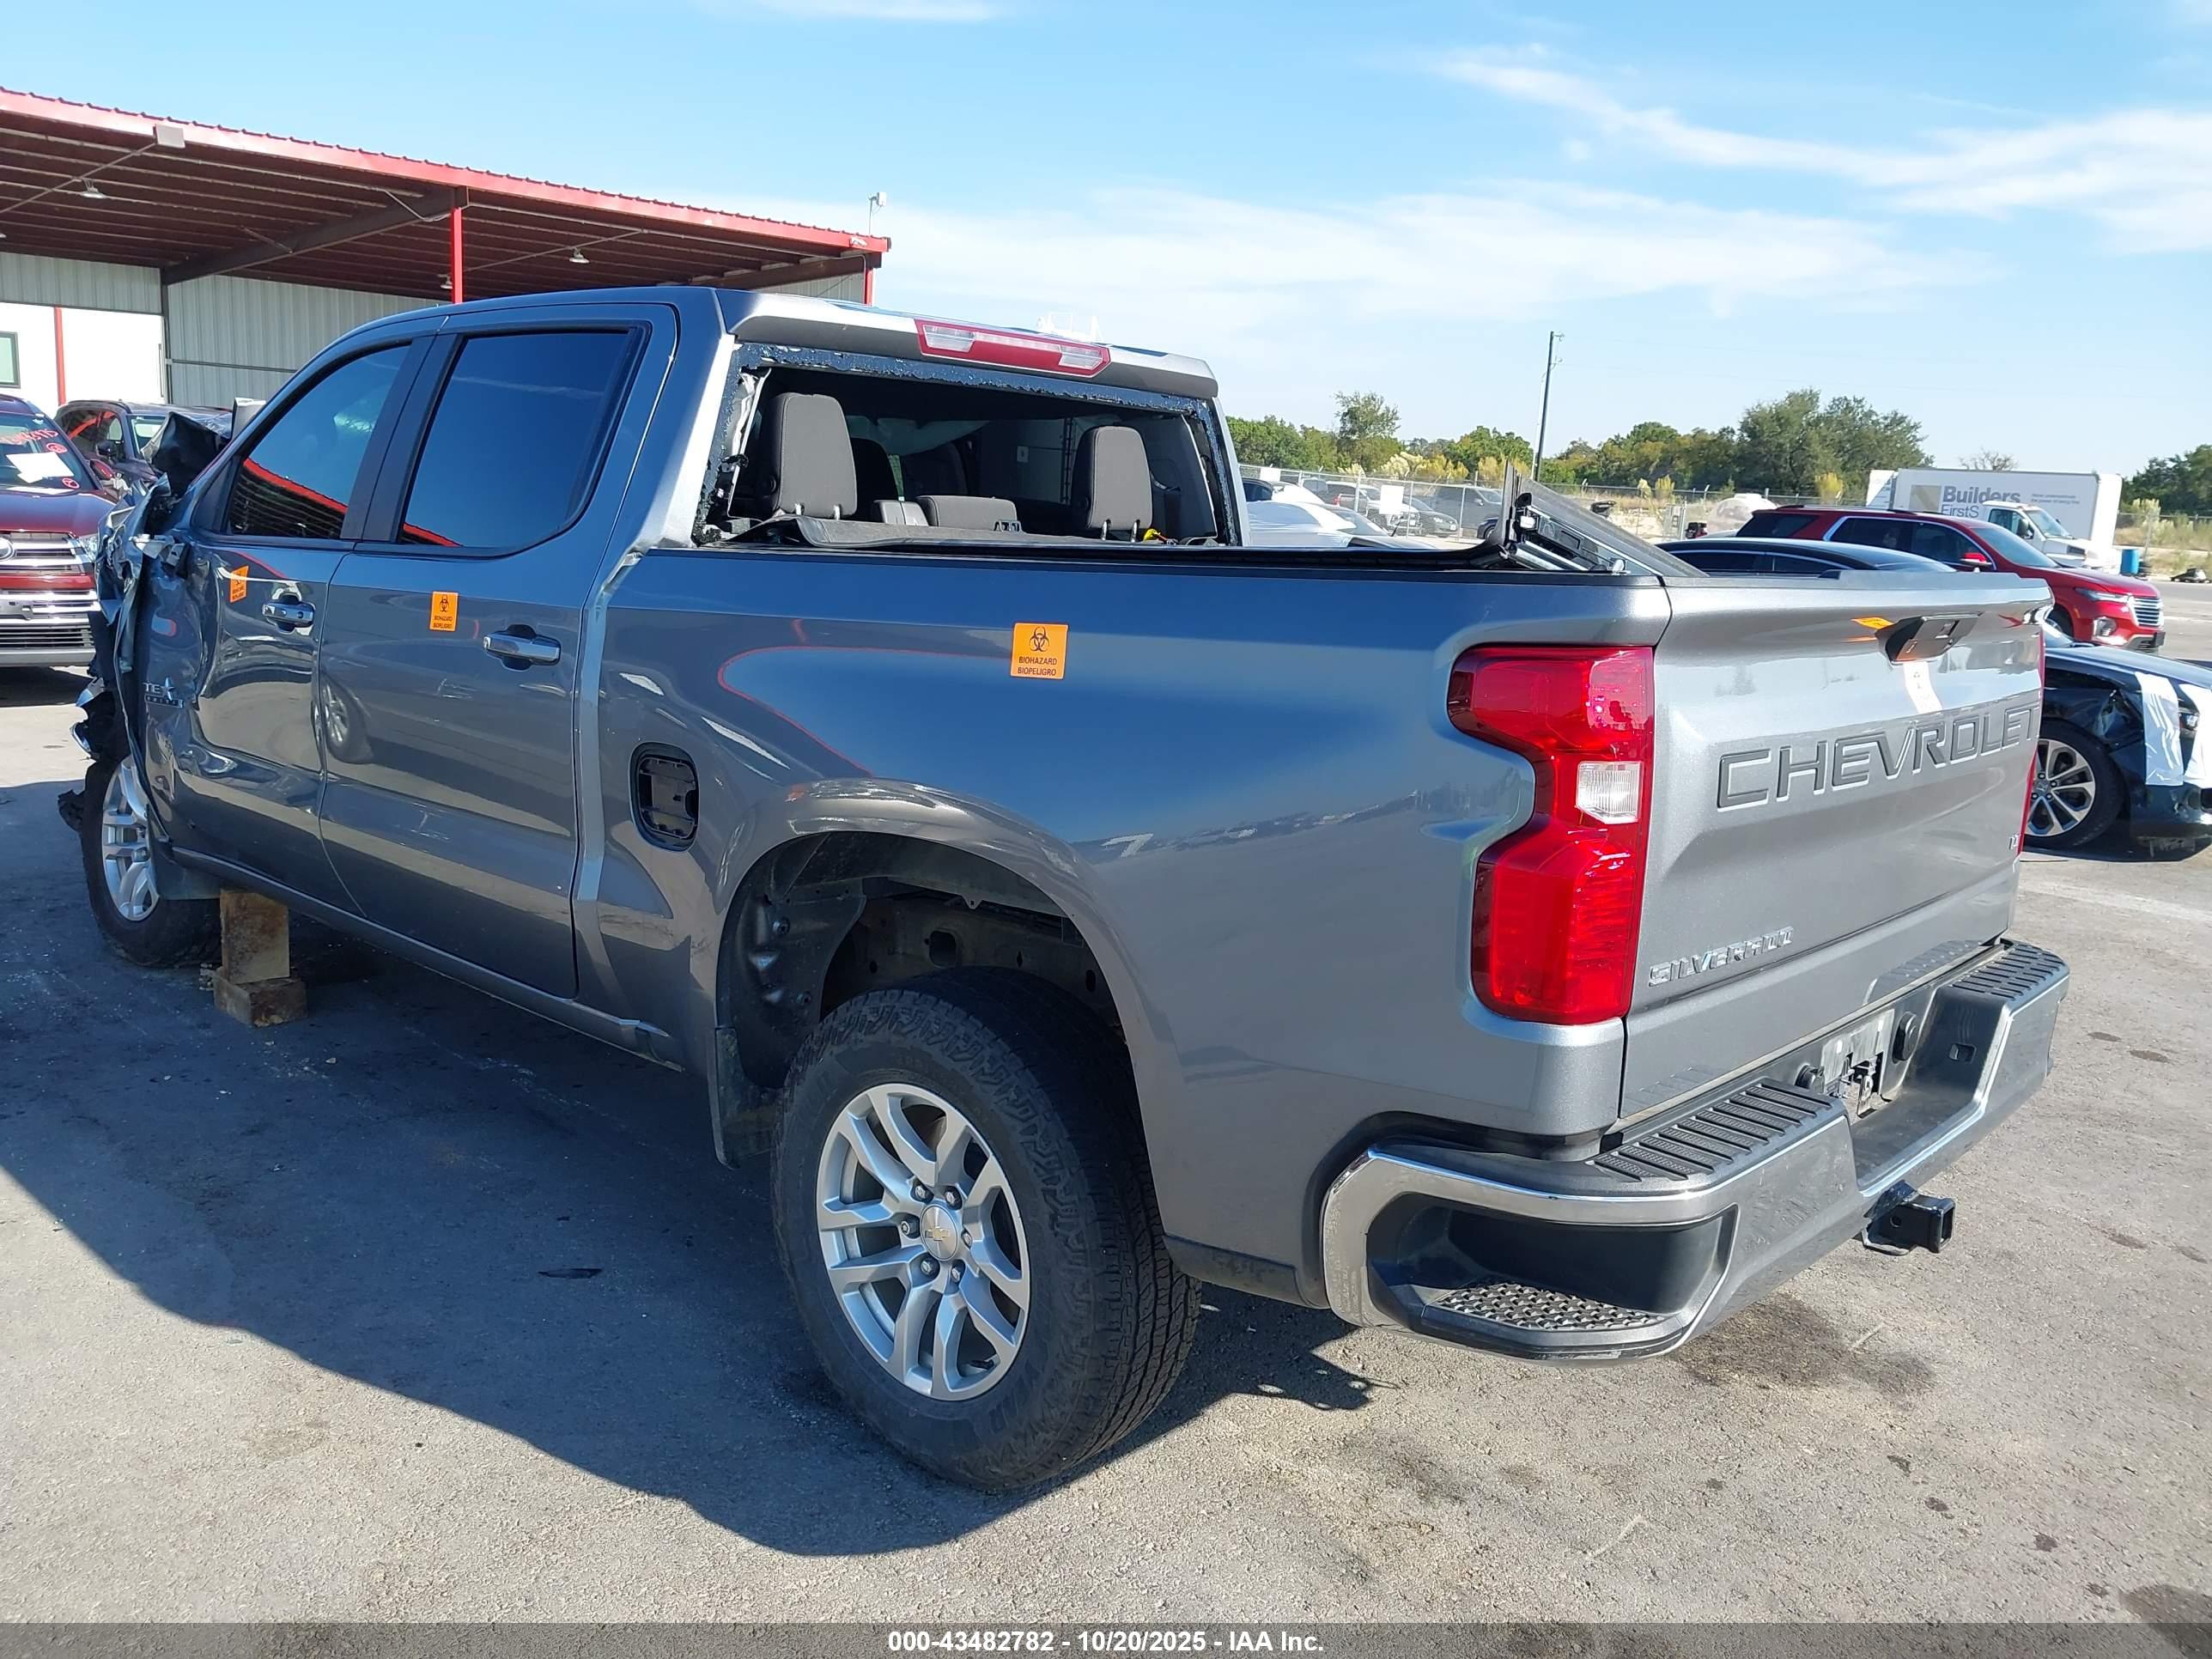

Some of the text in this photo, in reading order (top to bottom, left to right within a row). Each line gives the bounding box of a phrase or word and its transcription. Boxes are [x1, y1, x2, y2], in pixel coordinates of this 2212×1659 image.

[1942, 485, 2021, 504] Builders
[1941, 503, 1980, 519] FirstS
[1018, 656, 1057, 665] BIOHAZARD
[1017, 666, 1057, 677] BIOPELIGRO
[1717, 706, 2039, 811] CHEVROLET
[1648, 926, 1795, 988] SILVERADO
